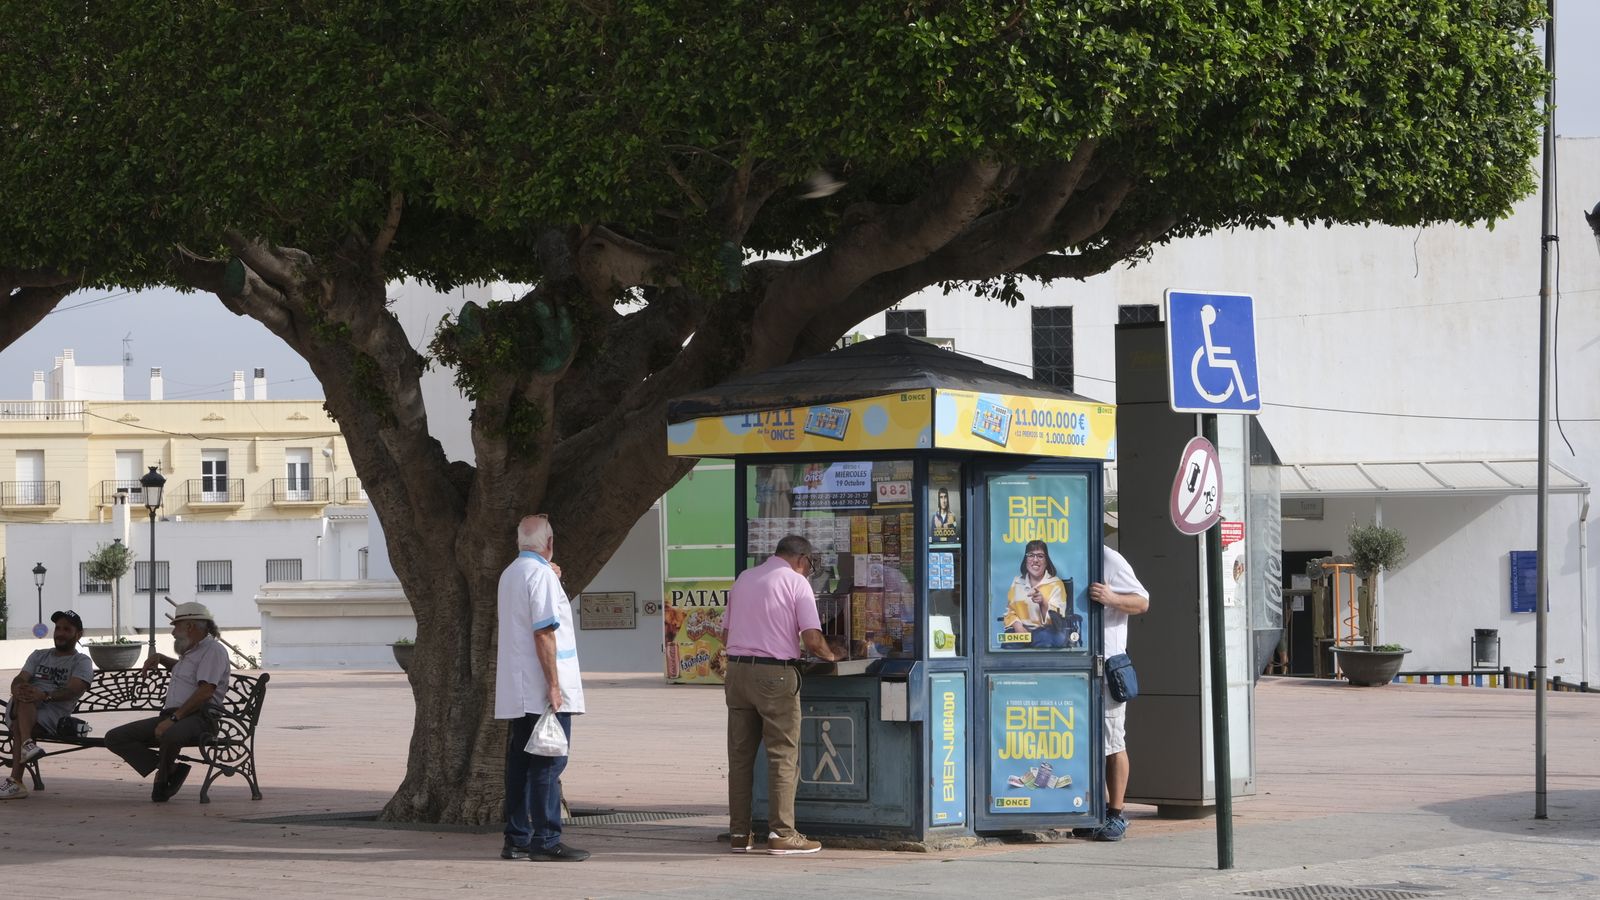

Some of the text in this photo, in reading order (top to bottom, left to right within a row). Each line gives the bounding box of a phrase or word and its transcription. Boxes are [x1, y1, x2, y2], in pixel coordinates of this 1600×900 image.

[770, 428, 795, 440] ONCE
[880, 484, 907, 496] 082
[1008, 495, 1069, 517] BIEN
[1002, 518, 1069, 544] JUGADO
[943, 691, 955, 745] JUGADO
[1005, 706, 1074, 730] BIEN
[998, 731, 1074, 760] JUGADO
[943, 745, 955, 802] BIEN
[1005, 798, 1029, 806] ONCE
